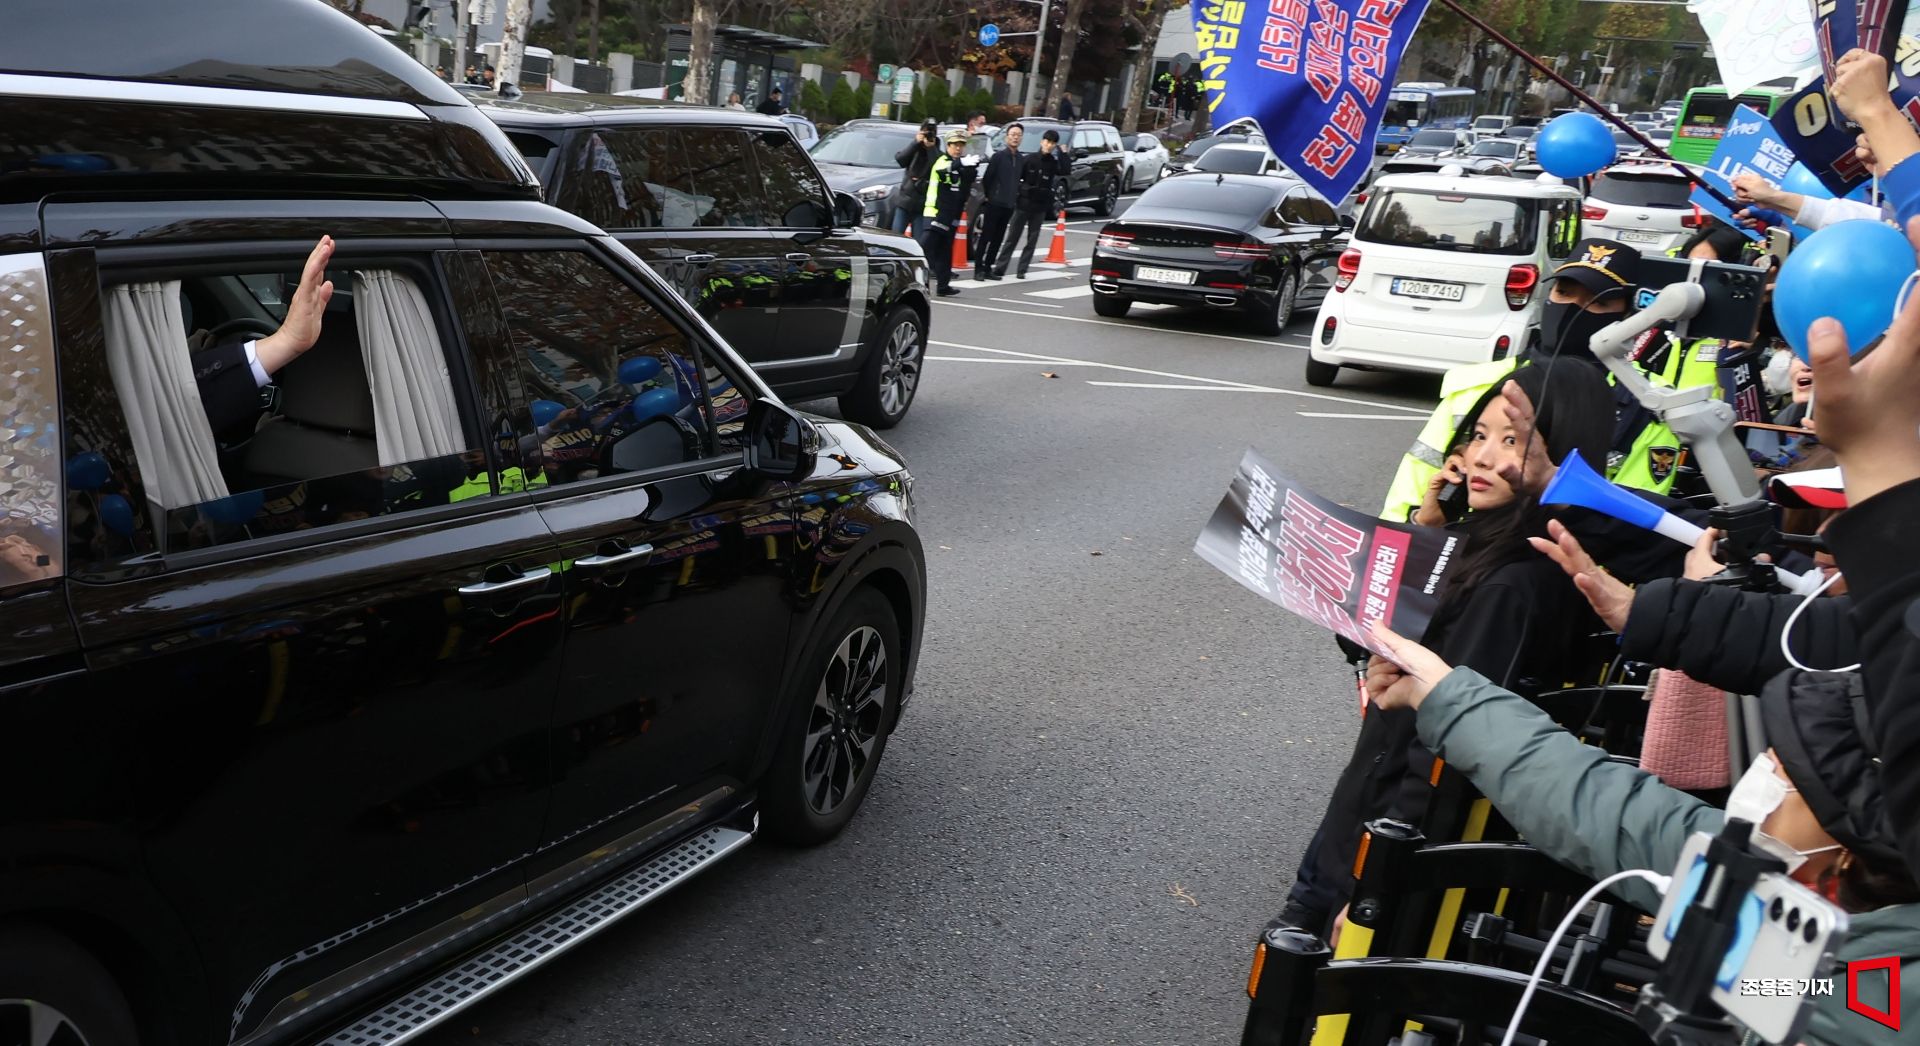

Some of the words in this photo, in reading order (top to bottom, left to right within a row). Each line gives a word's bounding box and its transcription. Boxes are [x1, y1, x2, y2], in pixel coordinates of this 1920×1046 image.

[1257, 0, 1311, 75] 너희들
[1302, 92, 1367, 180] 천벌
[1368, 545, 1398, 595] 탄핵하라!
